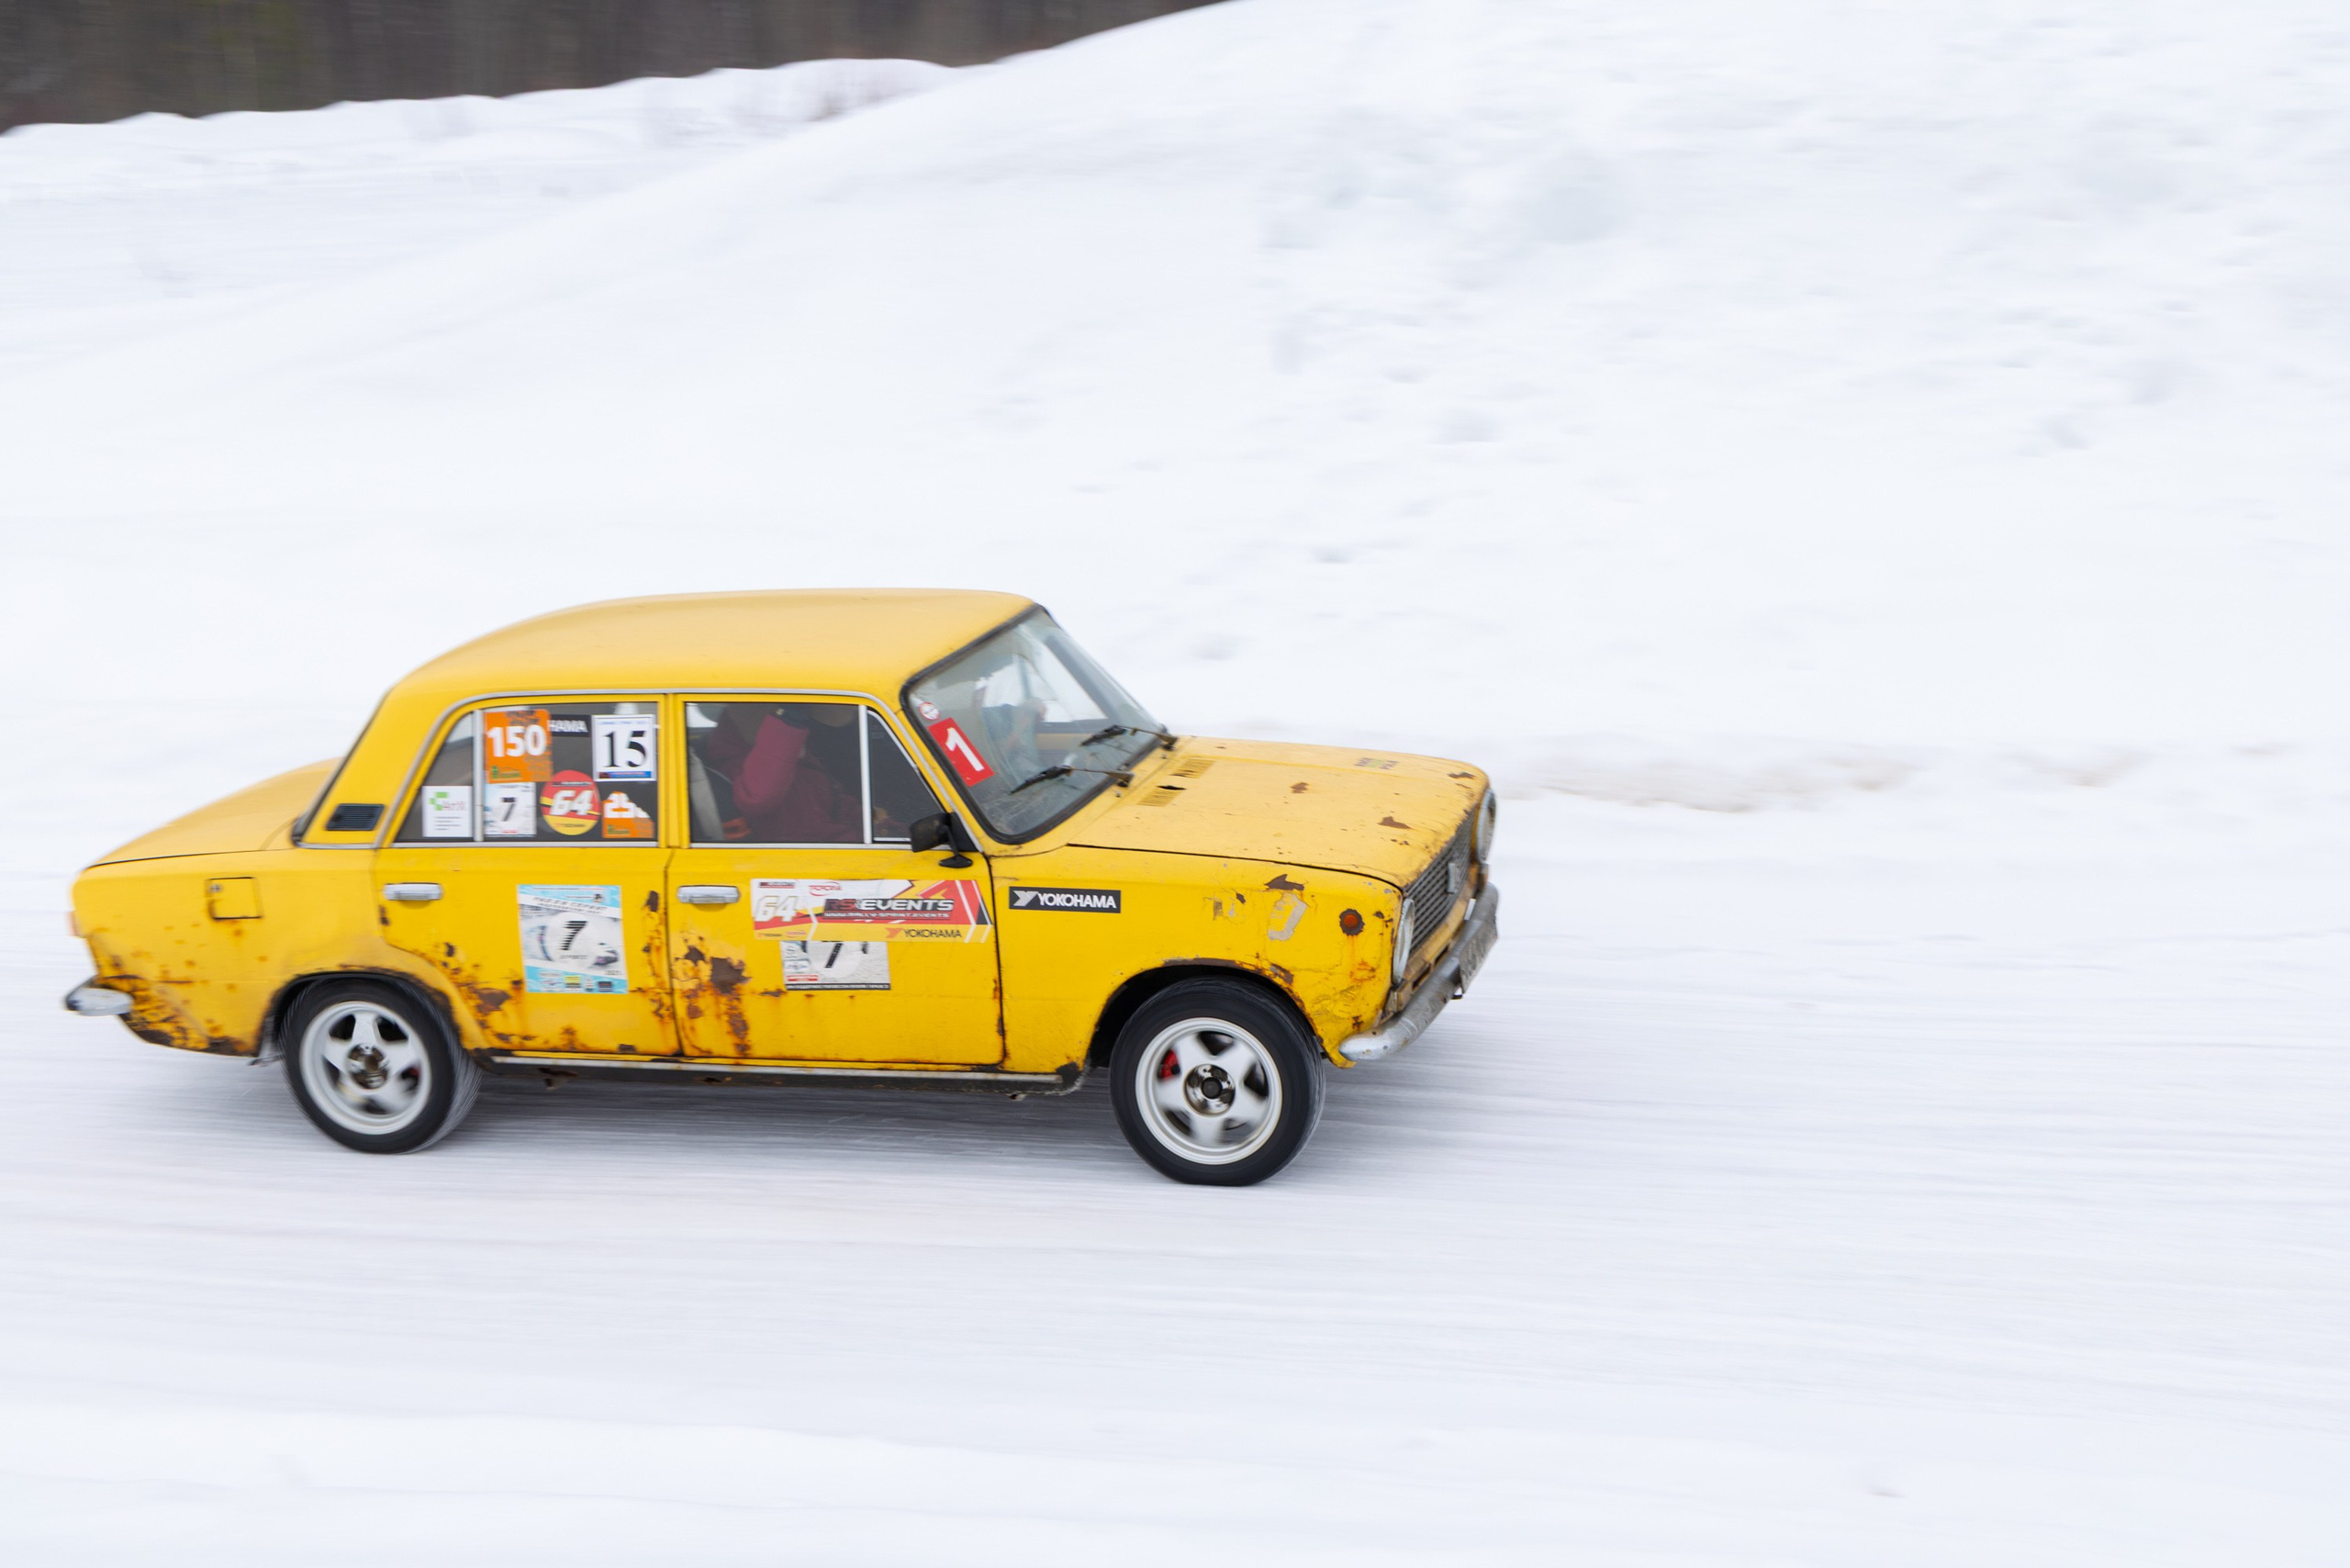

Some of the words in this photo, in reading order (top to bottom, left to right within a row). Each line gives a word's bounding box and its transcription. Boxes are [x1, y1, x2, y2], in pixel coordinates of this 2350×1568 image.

[487, 724, 546, 757] 150
[602, 730, 646, 767] 15
[946, 727, 985, 771] 1
[501, 797, 517, 822] 7
[550, 790, 595, 815] 64
[754, 895, 798, 922] 64
[1037, 892, 1117, 908] YOKOHAMA
[559, 920, 588, 950] 7
[903, 928, 962, 937] YOKOHAMA
